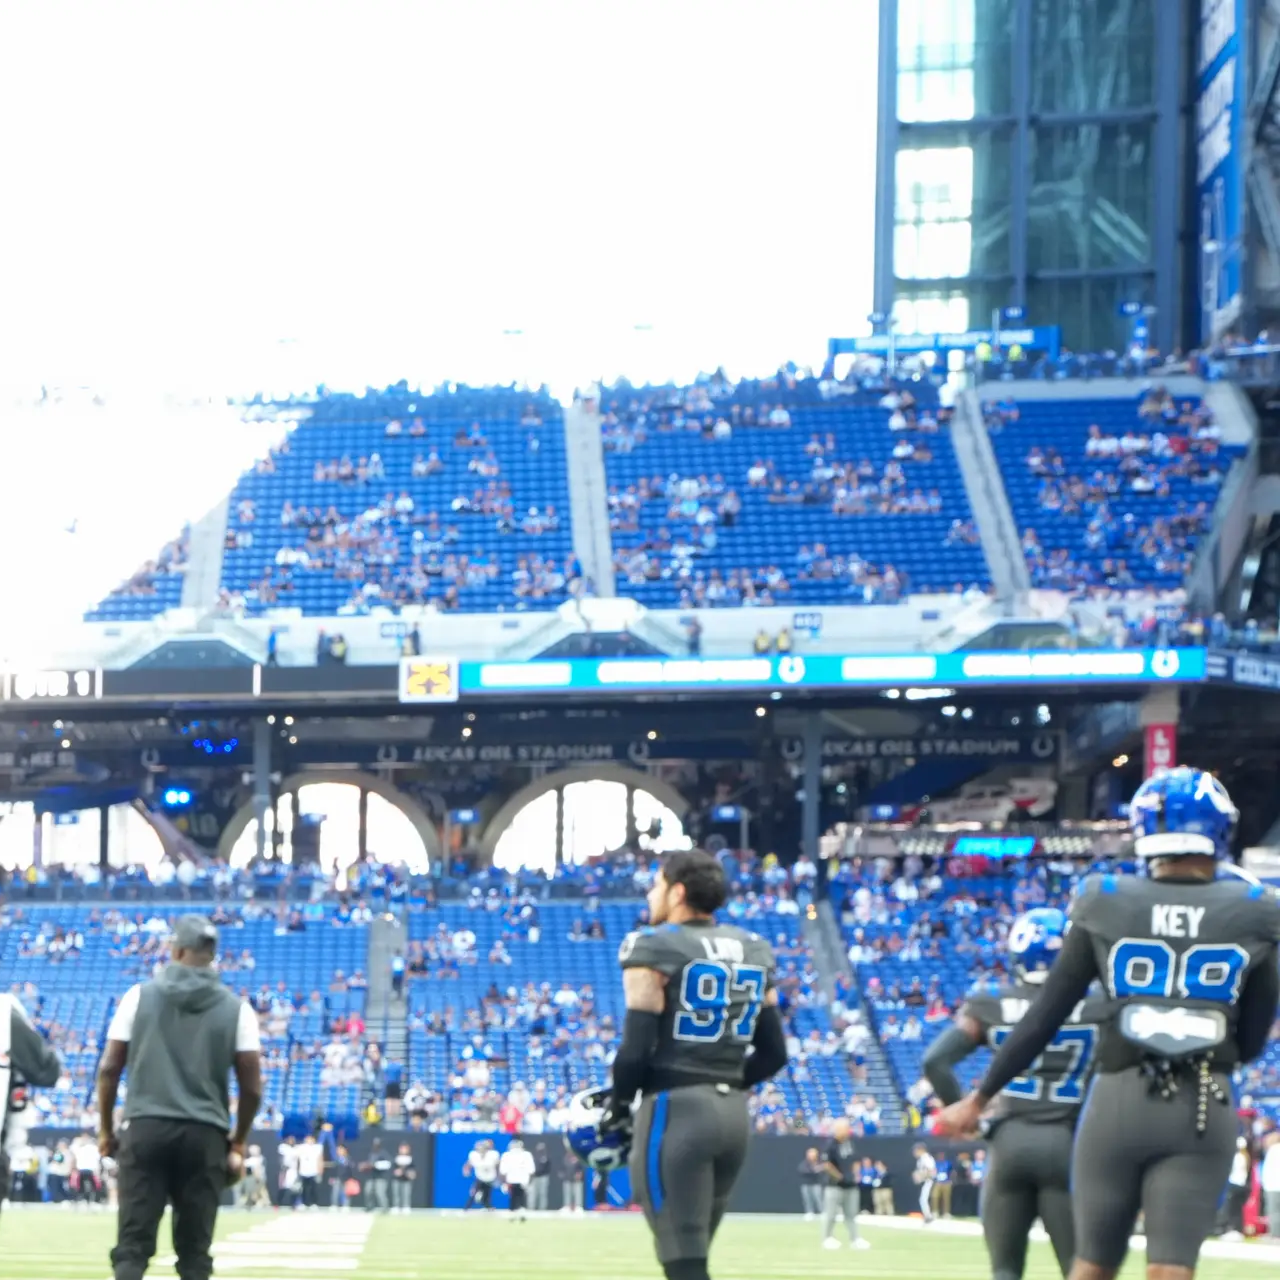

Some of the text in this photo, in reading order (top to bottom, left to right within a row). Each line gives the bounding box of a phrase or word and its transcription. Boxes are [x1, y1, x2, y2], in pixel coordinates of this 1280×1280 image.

[413, 743, 613, 761] LUCAS OIL STADIUM
[822, 740, 876, 756] UCAS
[920, 739, 1020, 754] STADIUM
[1151, 904, 1205, 938] KEY
[673, 958, 767, 1043] 97
